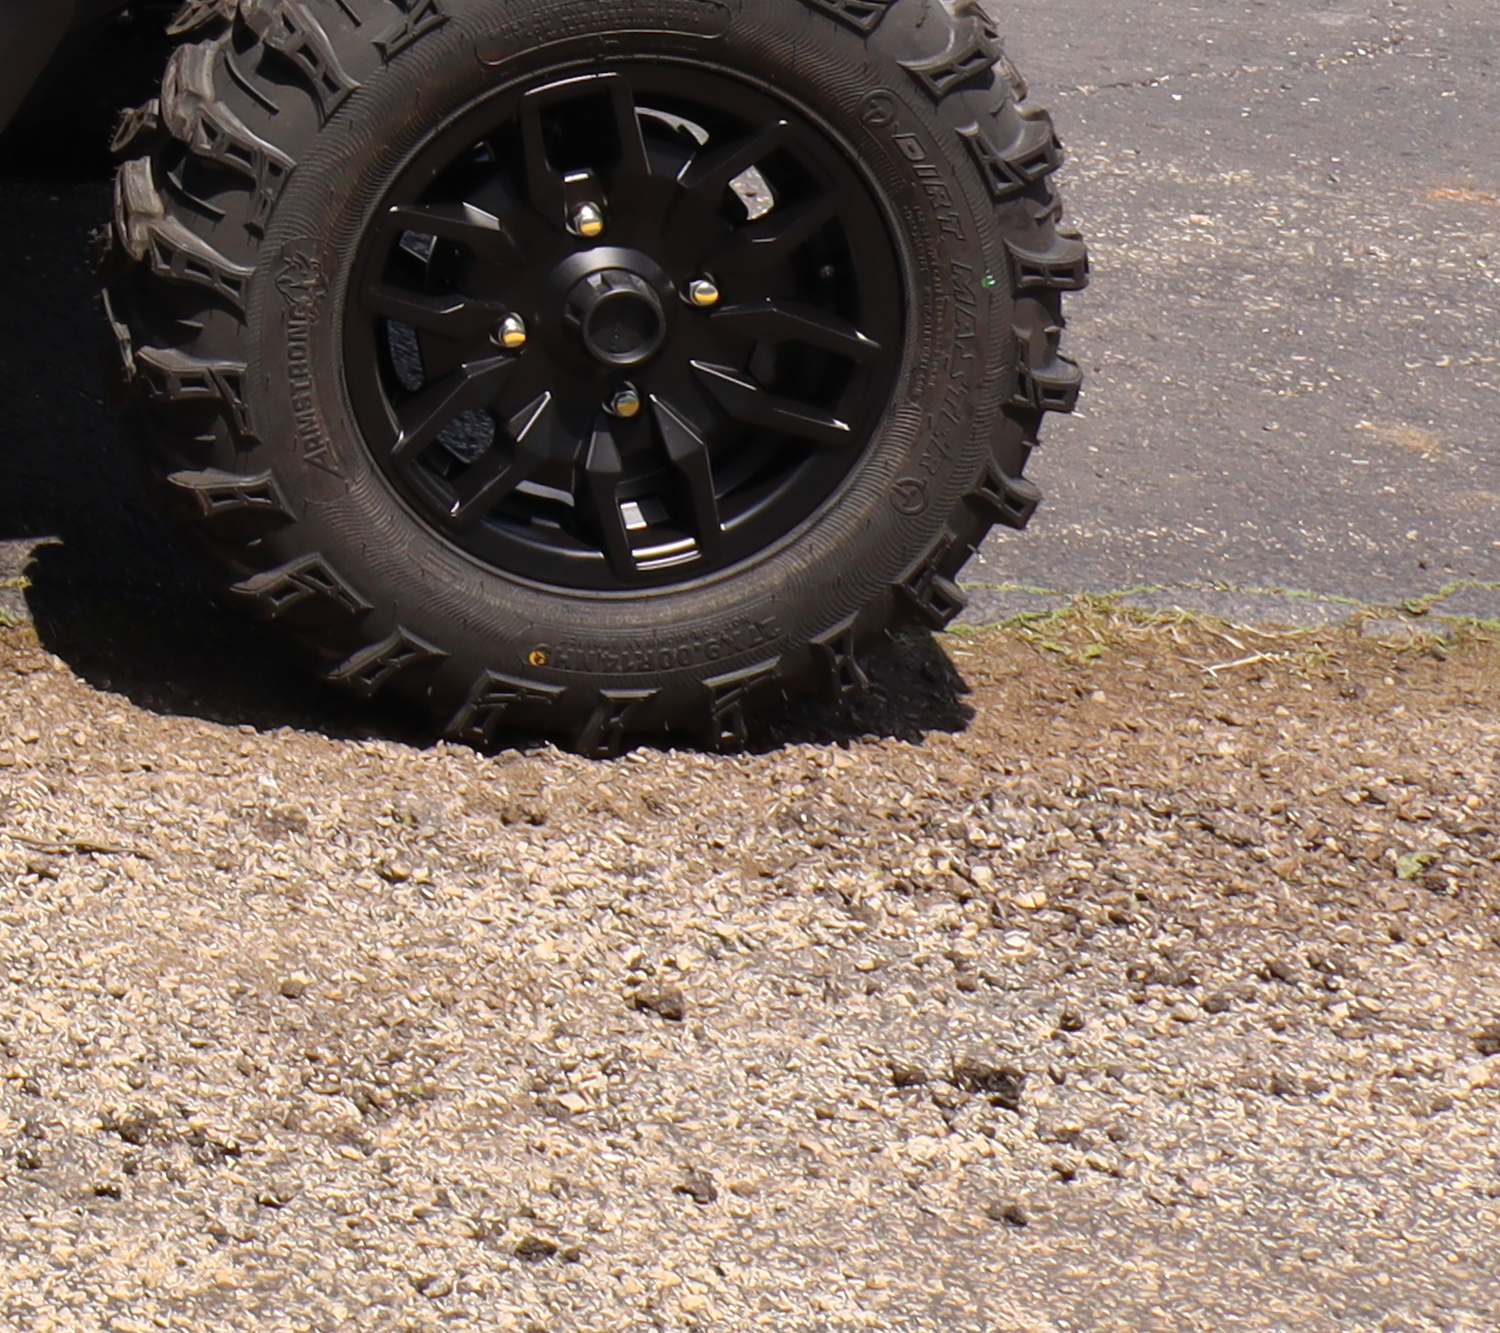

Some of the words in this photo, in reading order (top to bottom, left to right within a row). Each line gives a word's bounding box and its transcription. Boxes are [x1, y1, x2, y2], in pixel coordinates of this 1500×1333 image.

[892, 131, 967, 243] DIRT
[286, 302, 350, 484] ARMSTRONG
[919, 261, 978, 475] MASTER
